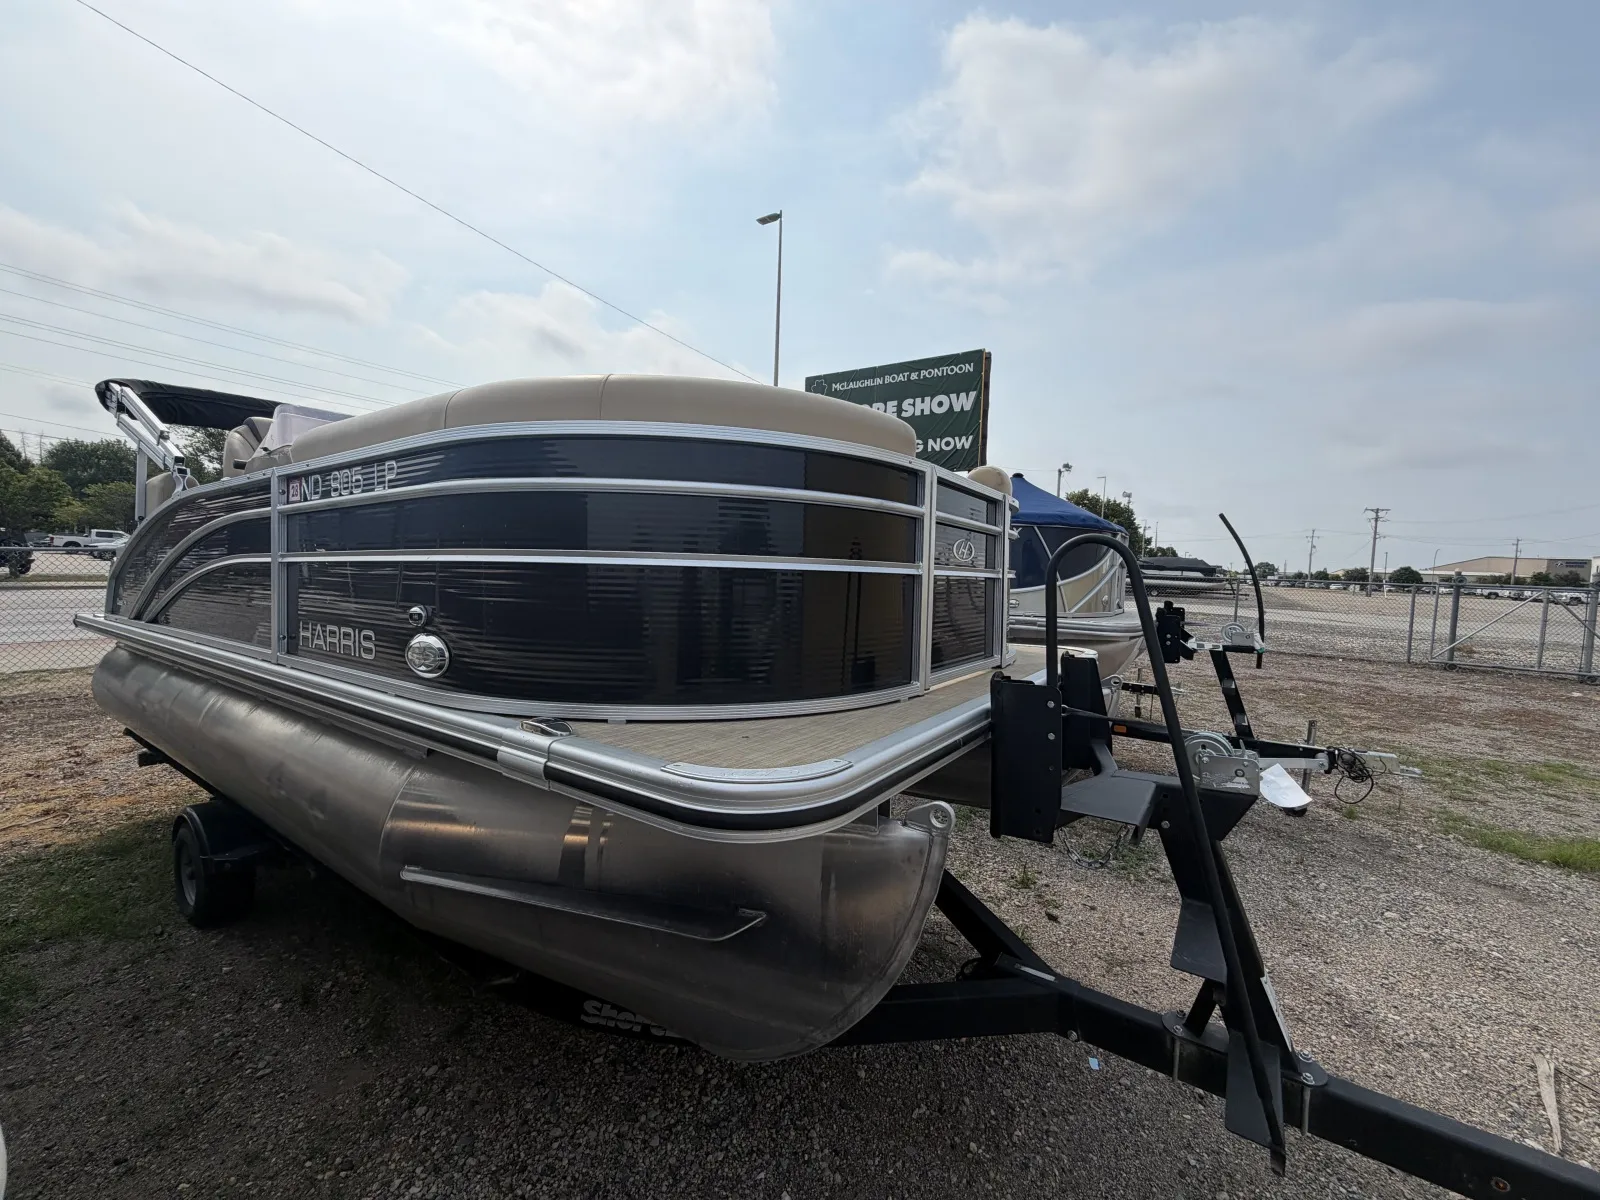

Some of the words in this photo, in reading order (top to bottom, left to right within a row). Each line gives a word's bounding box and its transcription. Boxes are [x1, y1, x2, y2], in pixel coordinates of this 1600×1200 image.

[884, 372, 910, 384] BOAT
[910, 371, 919, 380] &
[920, 363, 974, 379] PONTOON
[901, 391, 977, 418] SHOW
[928, 435, 974, 452] NOW
[301, 475, 322, 502] ND
[299, 620, 376, 660] HARRIS
